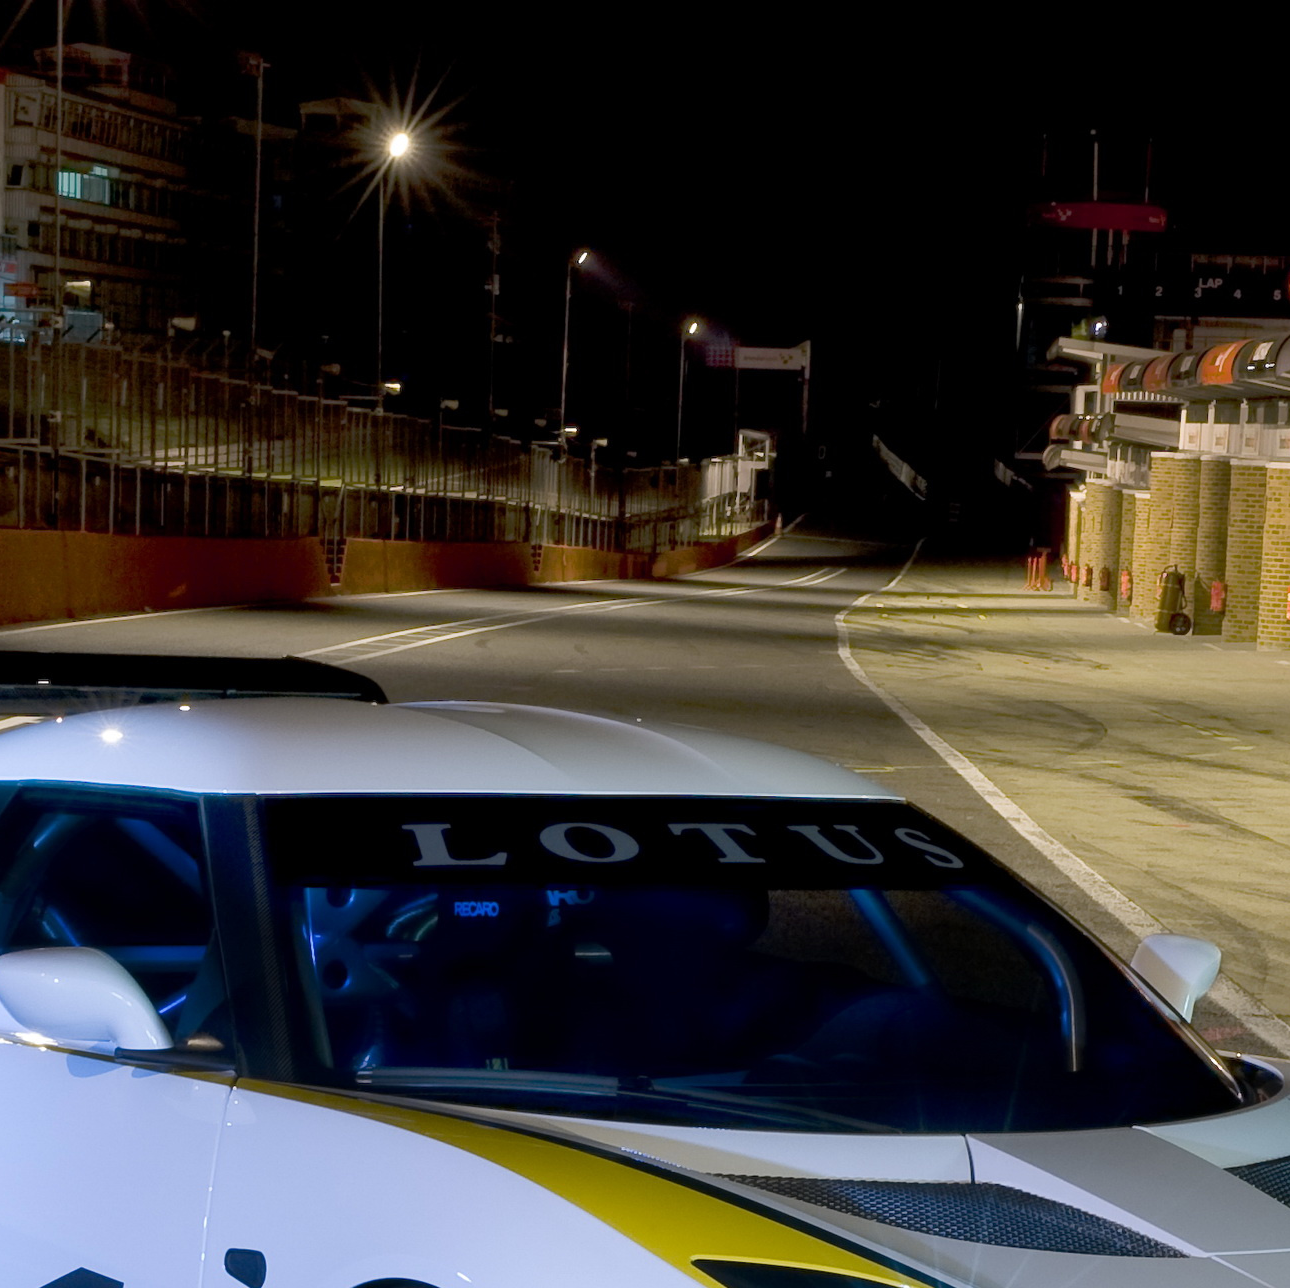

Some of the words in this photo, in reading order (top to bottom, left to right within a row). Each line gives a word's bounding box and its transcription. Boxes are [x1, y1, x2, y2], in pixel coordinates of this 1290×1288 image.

[1199, 278, 1223, 288] LAP
[1118, 286, 1123, 295] 1
[1155, 286, 1162, 296] 2
[1195, 287, 1202, 297] 3
[1234, 289, 1242, 298] 4
[1273, 290, 1281, 300] 5
[401, 823, 964, 868] LOTUS
[454, 901, 500, 917] RECARO
